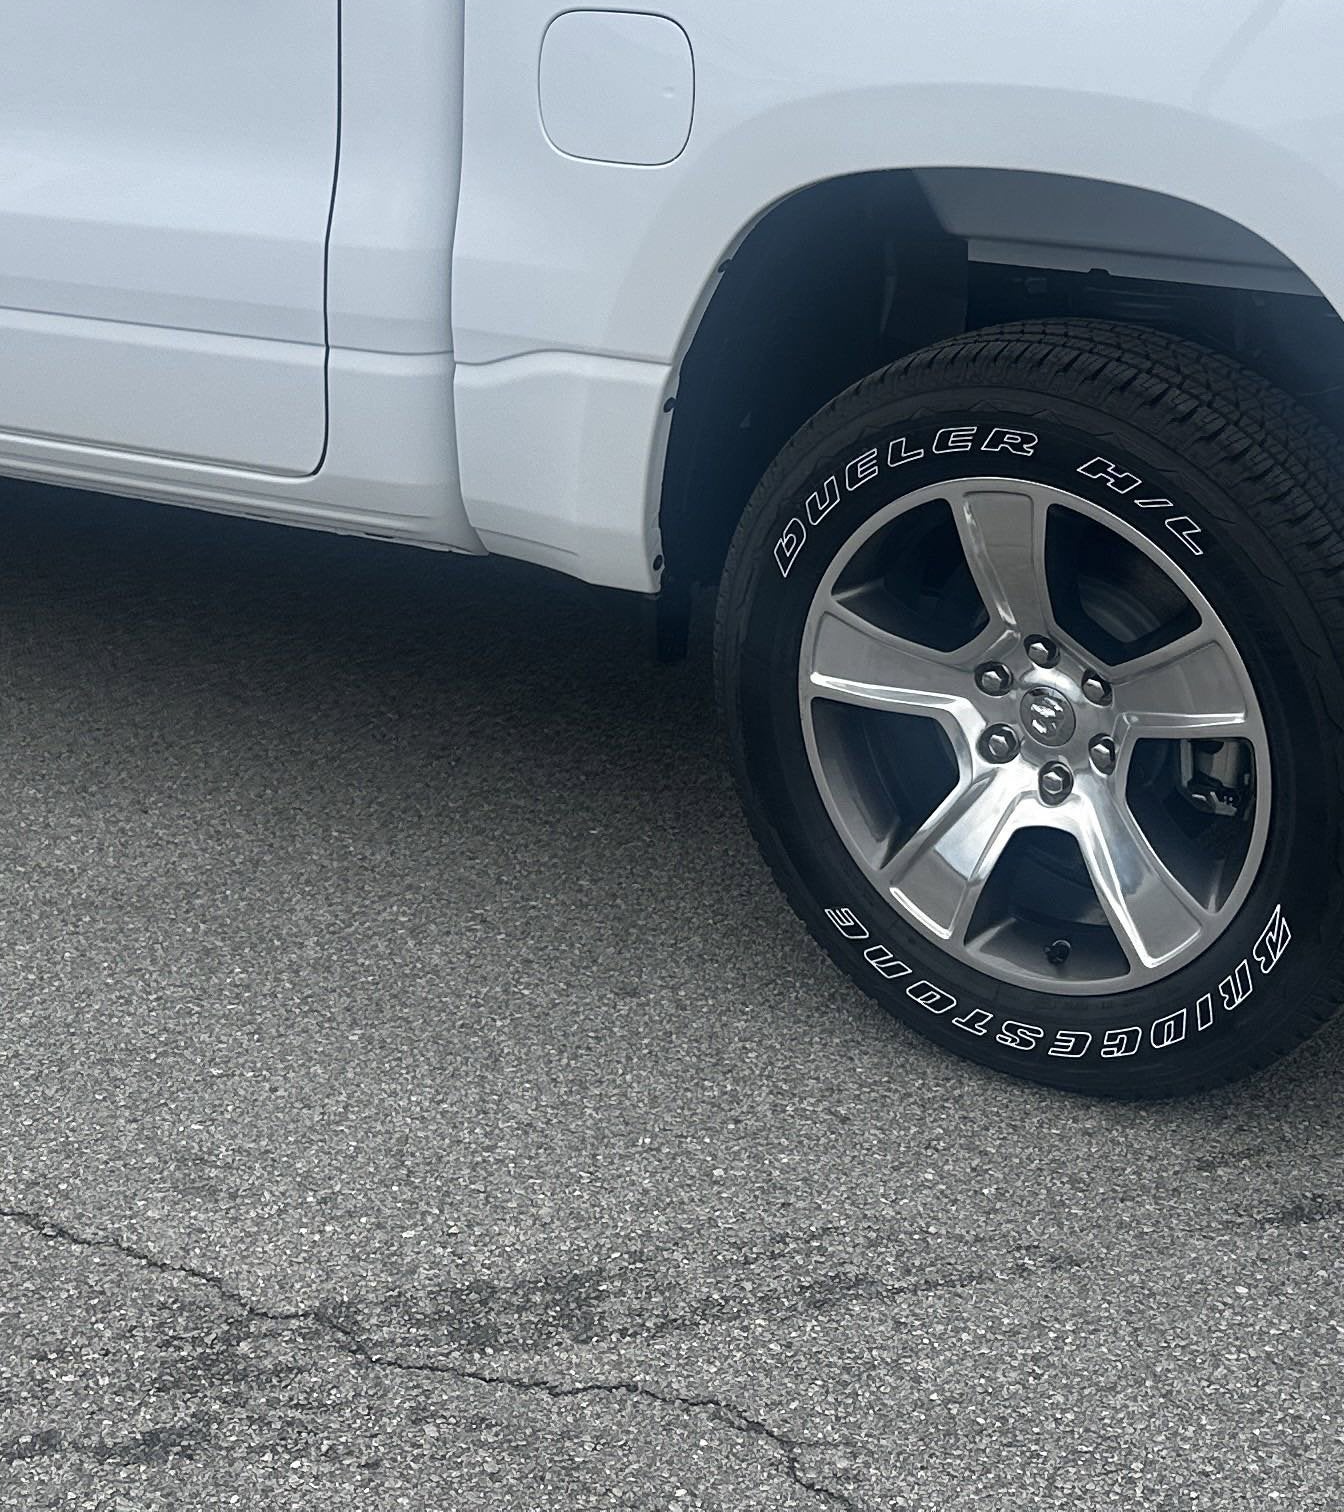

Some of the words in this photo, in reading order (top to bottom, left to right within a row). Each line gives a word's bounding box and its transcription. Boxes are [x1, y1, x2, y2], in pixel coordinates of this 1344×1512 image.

[773, 426, 1038, 578] DUELER
[1077, 456, 1204, 556] H/L
[824, 903, 1293, 1059] BRIDGESTONE
